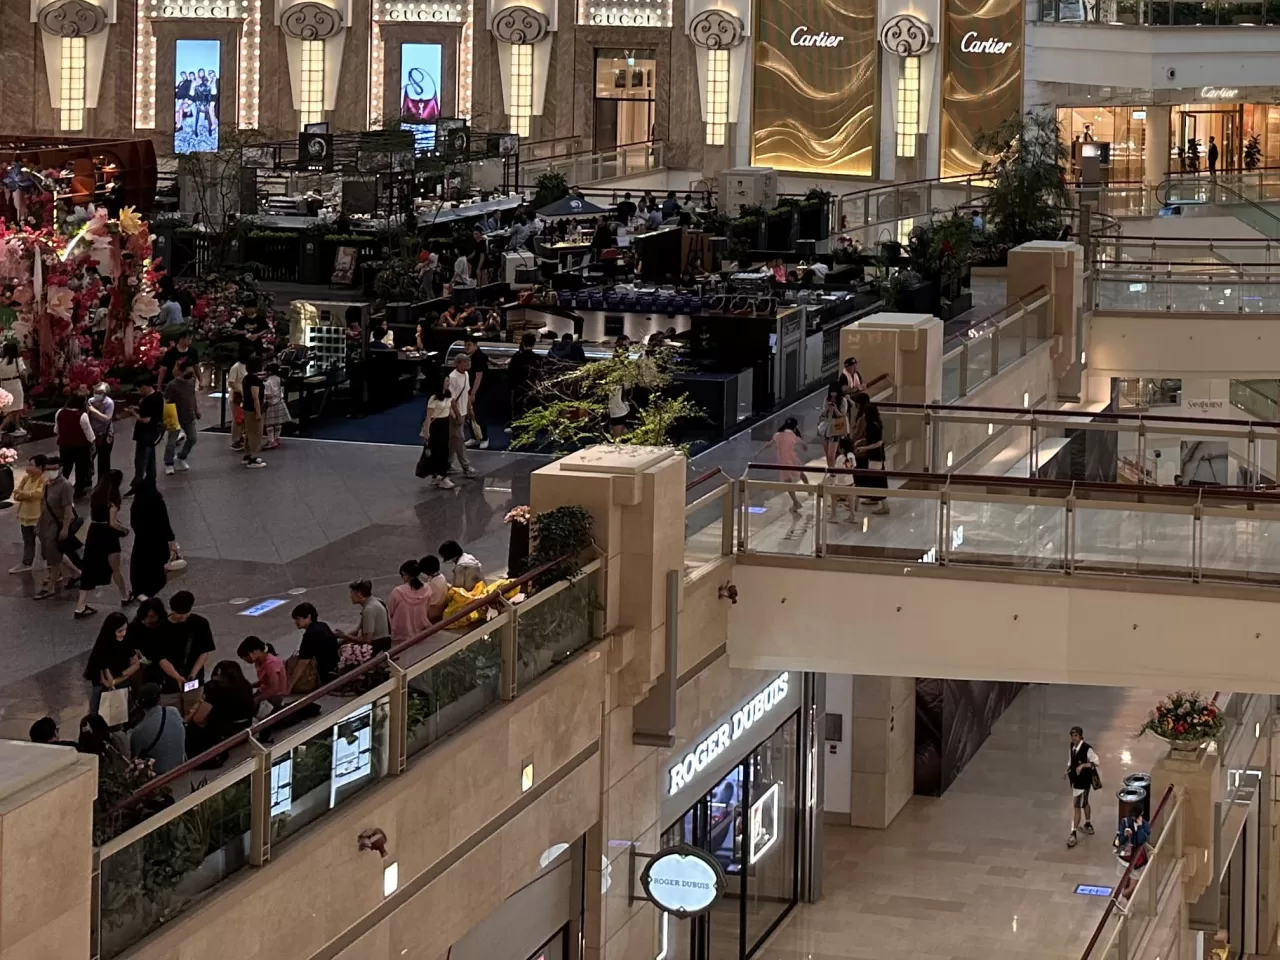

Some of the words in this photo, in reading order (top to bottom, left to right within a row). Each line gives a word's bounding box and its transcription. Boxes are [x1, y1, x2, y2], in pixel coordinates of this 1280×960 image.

[163, 6, 230, 17] GUCCI
[389, 9, 450, 21] GUCCI
[592, 13, 650, 25] GUCCI
[790, 26, 844, 47] Cartier
[961, 31, 1012, 54] Cartier
[1201, 86, 1239, 98] Cartier
[669, 723, 731, 796] ROGER
[731, 671, 789, 741] DUBUIS
[653, 878, 680, 887] ROGER
[681, 880, 710, 890] DUBUIS
